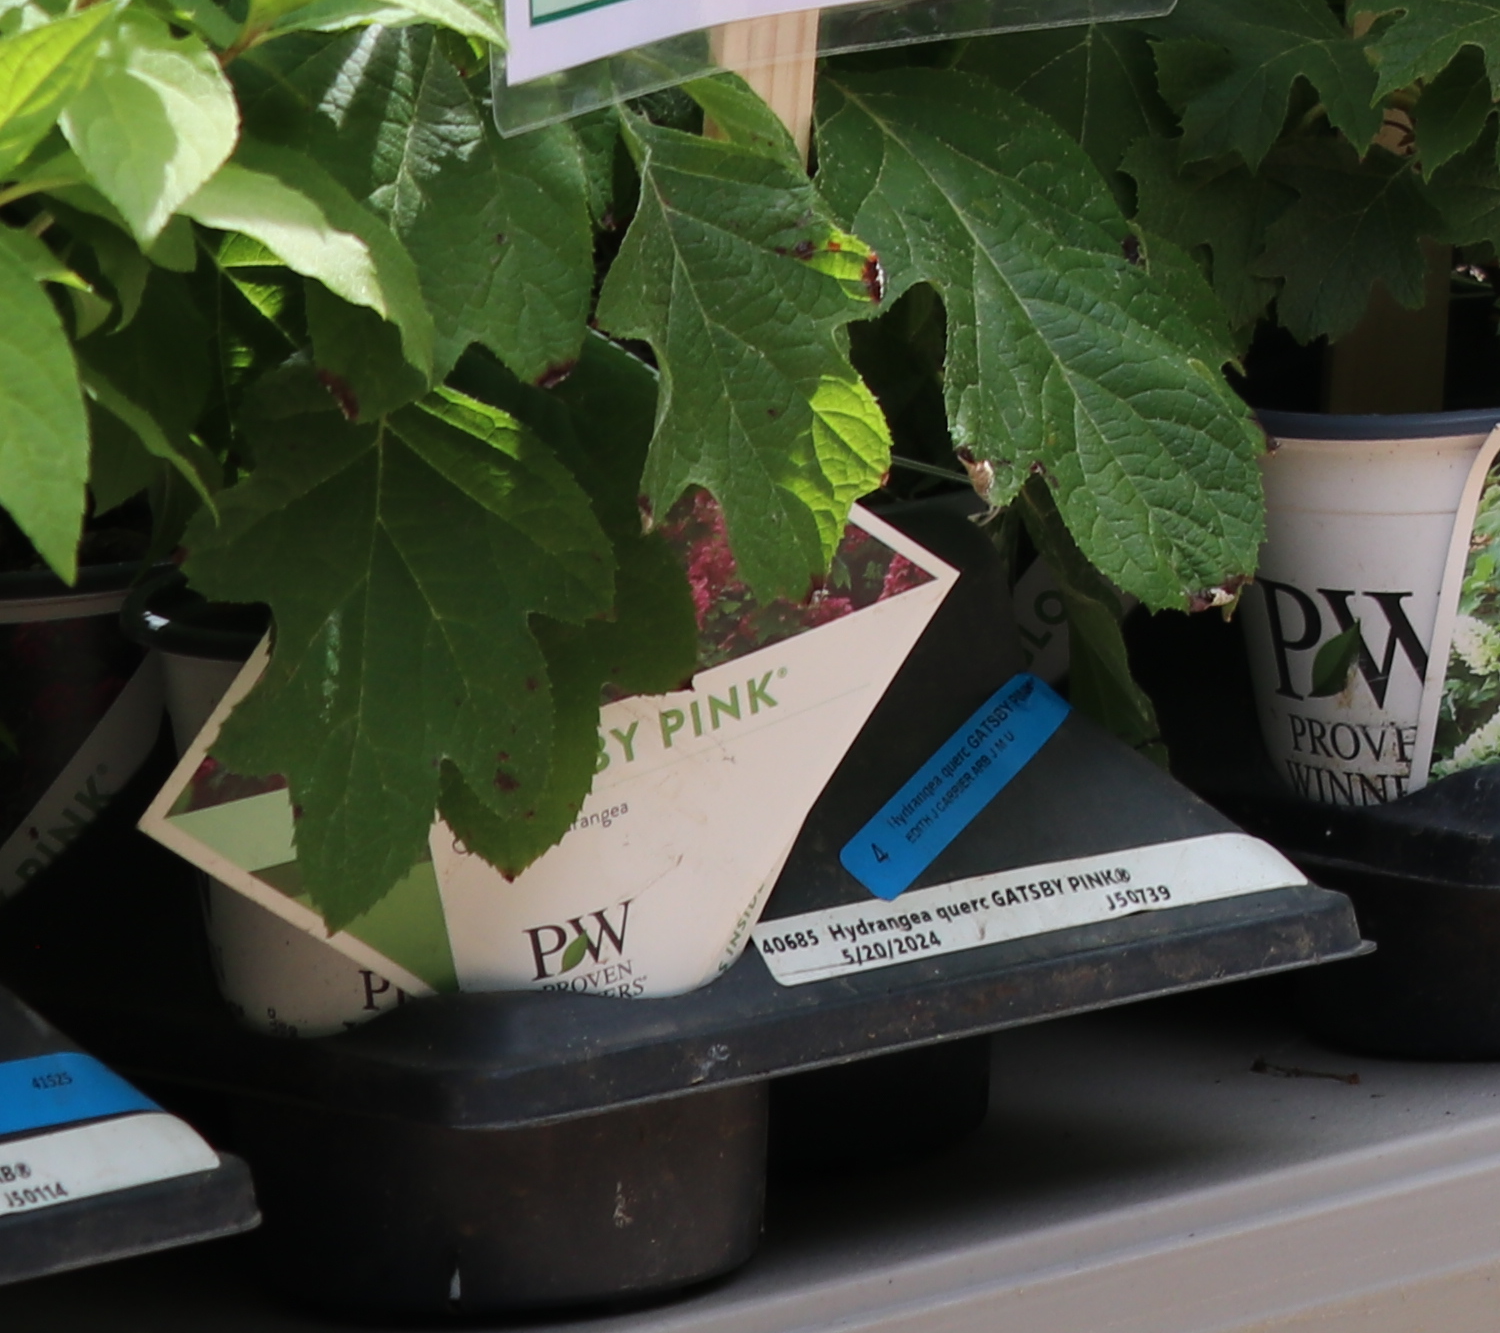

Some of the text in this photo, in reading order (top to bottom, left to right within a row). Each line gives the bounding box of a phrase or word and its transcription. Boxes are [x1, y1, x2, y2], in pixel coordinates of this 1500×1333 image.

[1254, 578, 1429, 710] PW
[887, 776, 943, 830] Hydrangea
[940, 746, 971, 784] querc
[967, 703, 1013, 751] GATSBY
[1289, 714, 1418, 762] PROVE
[566, 801, 629, 832] rangea
[905, 815, 933, 843] EDITH
[936, 772, 976, 813] CARRIER
[971, 754, 991, 778] ARB
[870, 843, 889, 864] 4
[522, 898, 634, 981] PW
[762, 867, 1131, 956] 40685 Hydrangea querc GATSBY PINK®
[840, 885, 1172, 967] 5/20/2024 J50739
[31, 1071, 73, 1091] 41525
[6, 1182, 69, 1209] J50114
